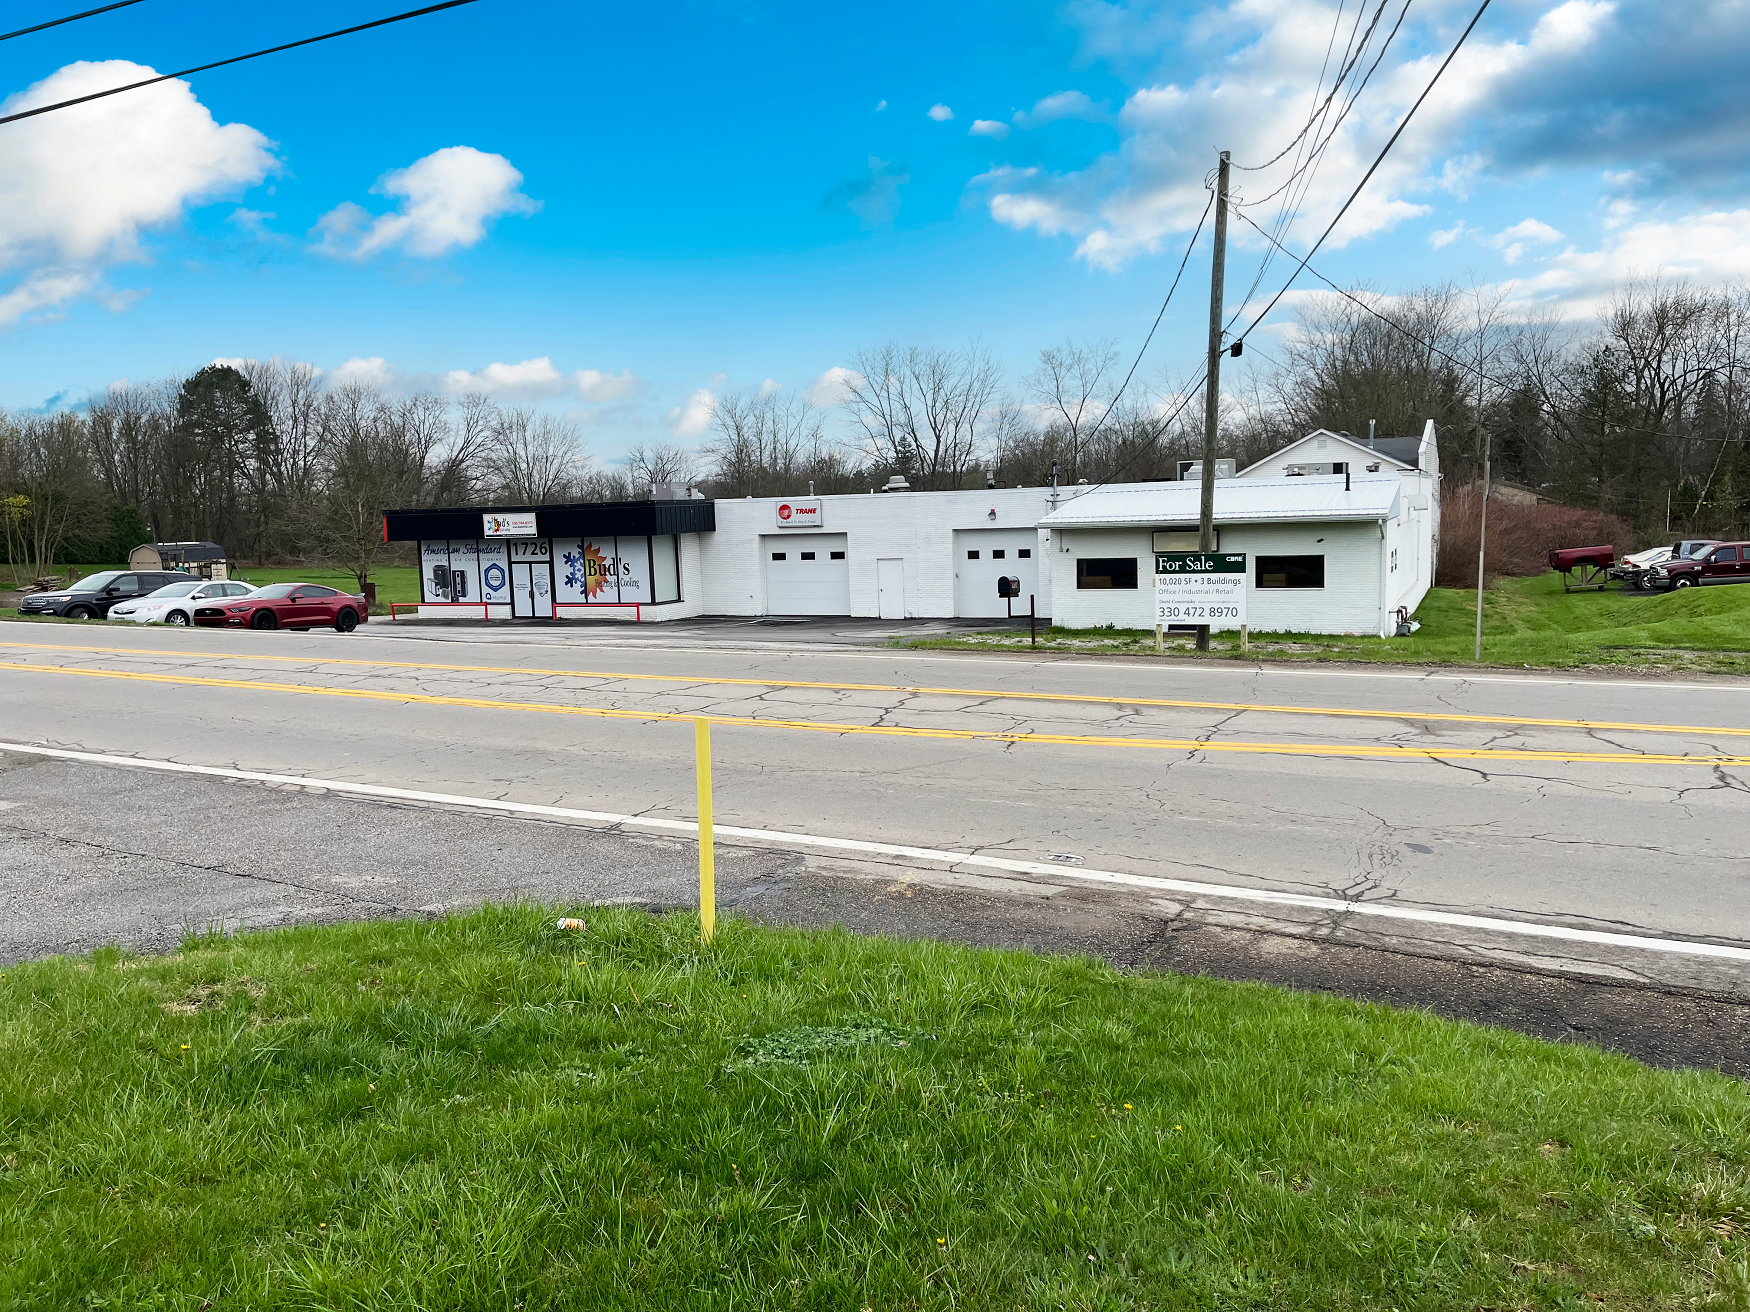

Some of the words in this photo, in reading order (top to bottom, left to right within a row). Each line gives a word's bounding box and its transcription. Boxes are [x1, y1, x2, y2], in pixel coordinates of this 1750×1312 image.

[423, 544, 460, 556] American
[463, 543, 503, 555] Standard
[513, 542, 548, 556] 1726
[587, 557, 630, 577] Bud's
[1158, 557, 1182, 571] For
[1186, 556, 1214, 570] Sale
[620, 577, 639, 590] Cooling
[1159, 578, 1182, 586] 10,020
[1207, 577, 1241, 586] Buildings
[1159, 607, 1180, 617] 330
[1183, 607, 1205, 617] 472
[1209, 607, 1238, 617] 8970
